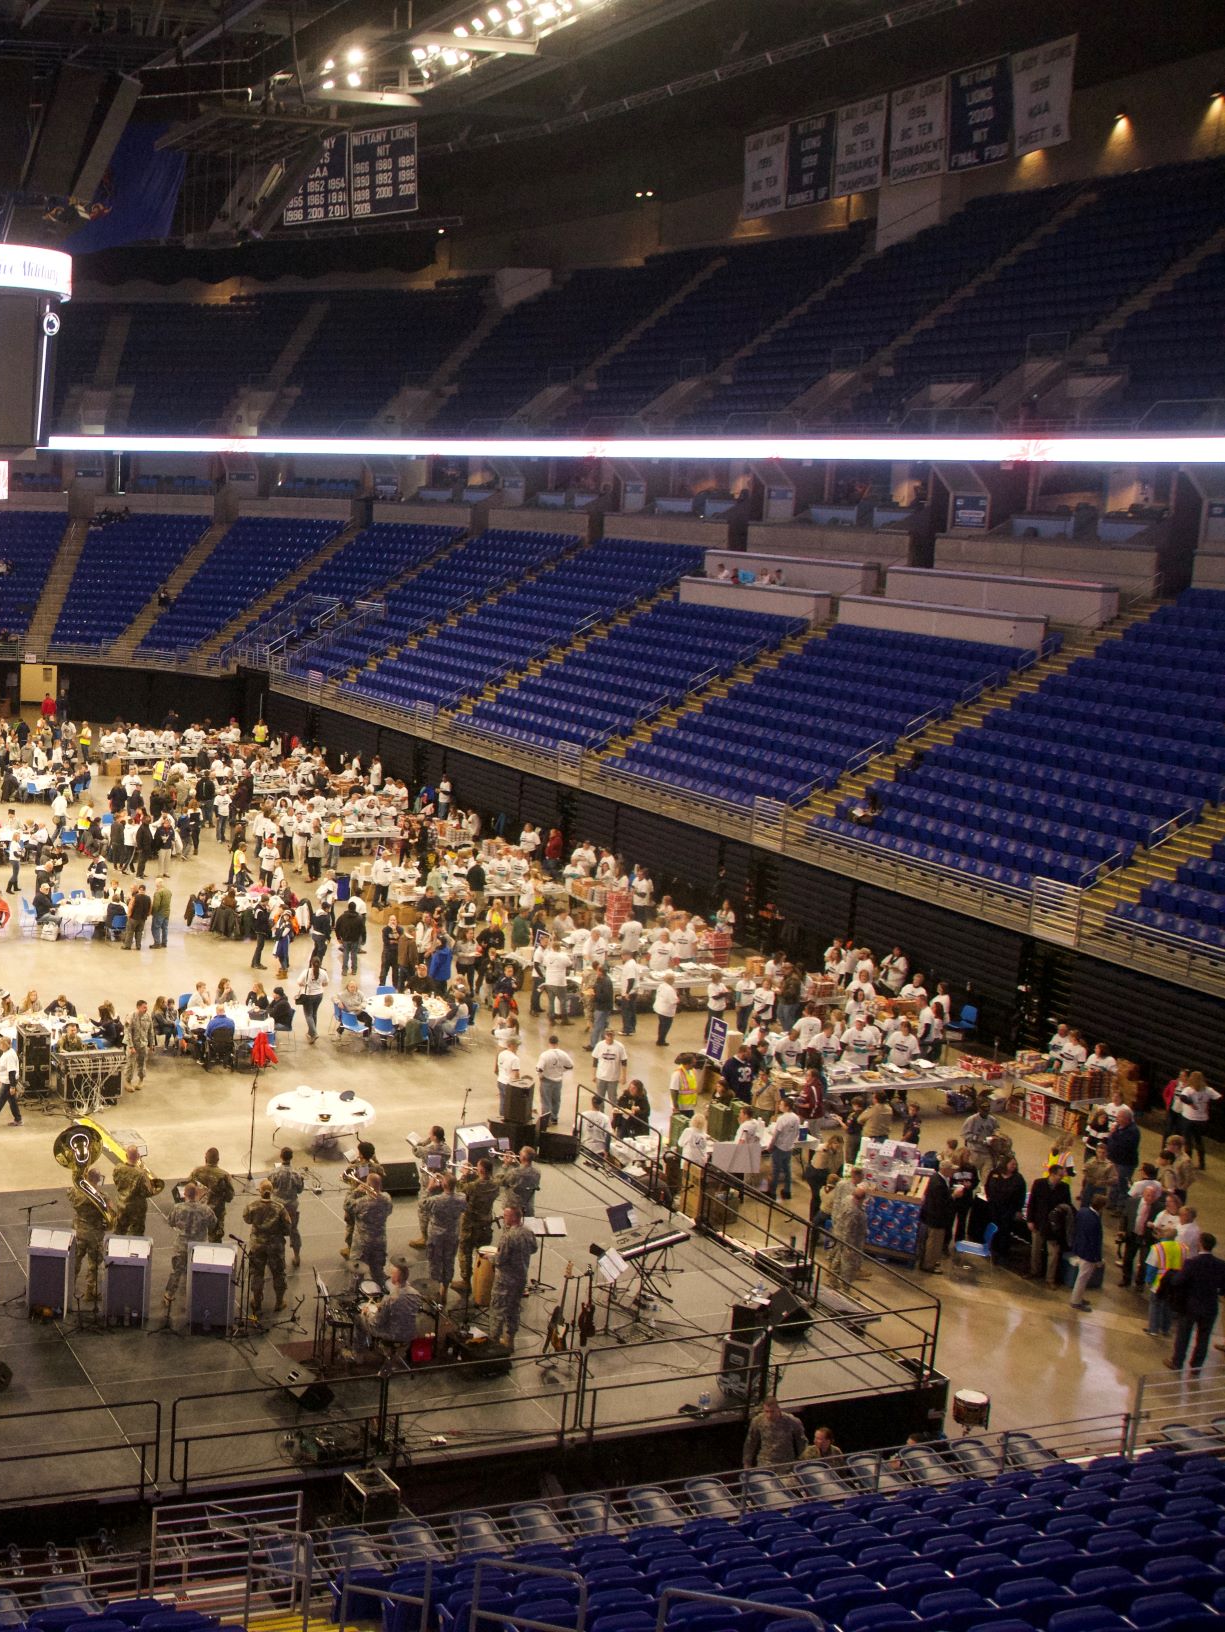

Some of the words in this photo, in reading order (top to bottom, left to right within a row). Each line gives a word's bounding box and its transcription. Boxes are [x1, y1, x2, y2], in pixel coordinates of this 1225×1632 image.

[352, 130, 387, 147] NITTANY
[390, 126, 415, 141] LIONS
[377, 144, 392, 157] NIT
[737, 1066, 751, 1082] 32
